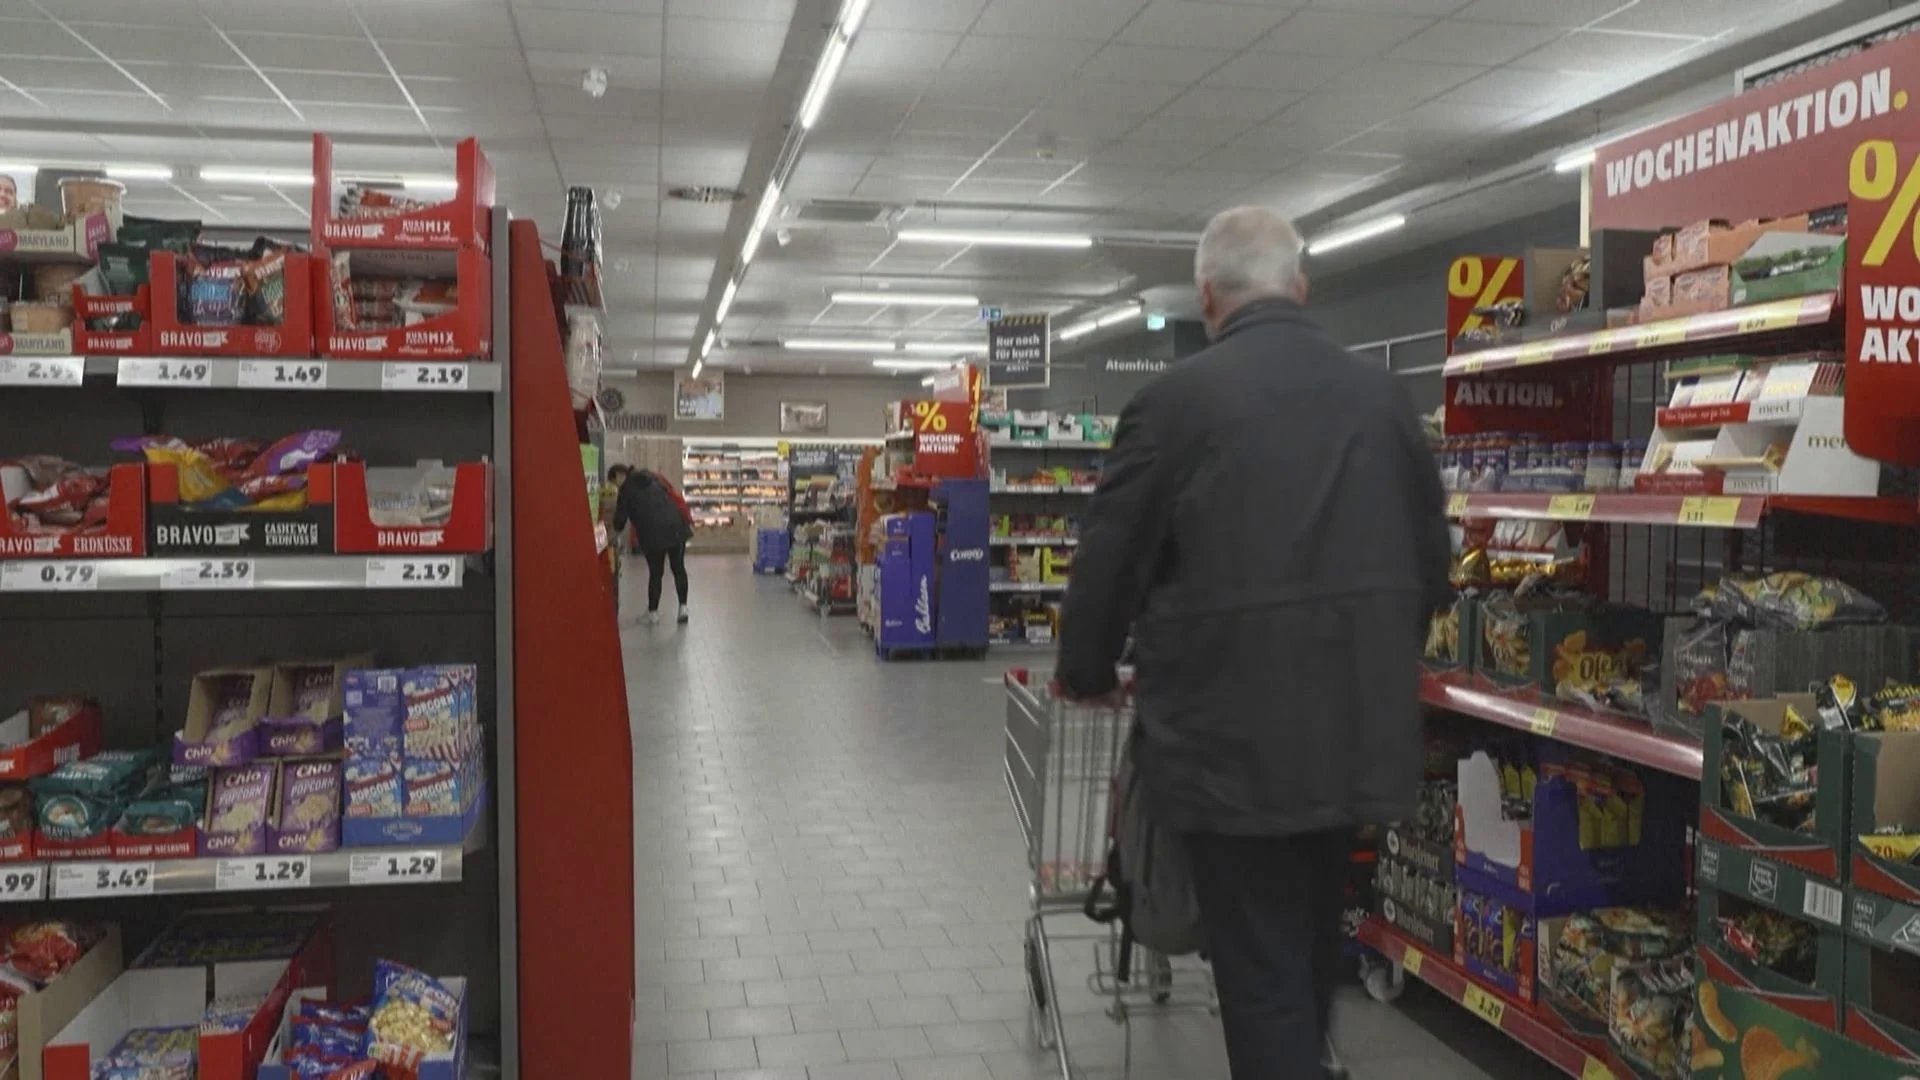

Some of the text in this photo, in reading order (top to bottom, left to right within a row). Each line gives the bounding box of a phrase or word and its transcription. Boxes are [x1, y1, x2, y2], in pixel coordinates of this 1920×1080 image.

[1606, 67, 1908, 198] WOCHENAKTION.
[325, 223, 362, 239] BRAVO
[160, 331, 200, 347] BRAVO
[329, 336, 366, 351] BRAVO
[996, 333, 1040, 347] Nur noch
[1860, 327, 1920, 363] AK
[158, 363, 206, 380] 1.49
[275, 365, 322, 382] 1.49
[417, 367, 463, 384] 2.19
[1454, 380, 1564, 408] AKTION.
[919, 434, 964, 444] WOCHEN-
[919, 444, 960, 454] AKTION.
[157, 524, 213, 545] BRAVO
[265, 522, 309, 534] CASHEW
[73, 534, 133, 553] ERDNÜSSE
[378, 531, 417, 547] BRAVO
[41, 564, 93, 582] 0.79
[199, 561, 249, 579] 2.39
[402, 563, 450, 580] 2.19
[408, 694, 455, 717] POPCORN
[270, 734, 297, 749] Chio
[184, 744, 213, 761] Chio
[225, 769, 261, 788] Chio
[297, 762, 333, 778] Chio
[291, 776, 335, 798] POPCORN
[350, 778, 398, 802] POPCORN
[409, 778, 457, 802] POPCORN
[207, 835, 236, 850] Chio
[279, 833, 307, 849] Chio
[255, 861, 305, 881] 1.29
[387, 857, 436, 877] 1.29
[97, 868, 149, 889] 3.49
